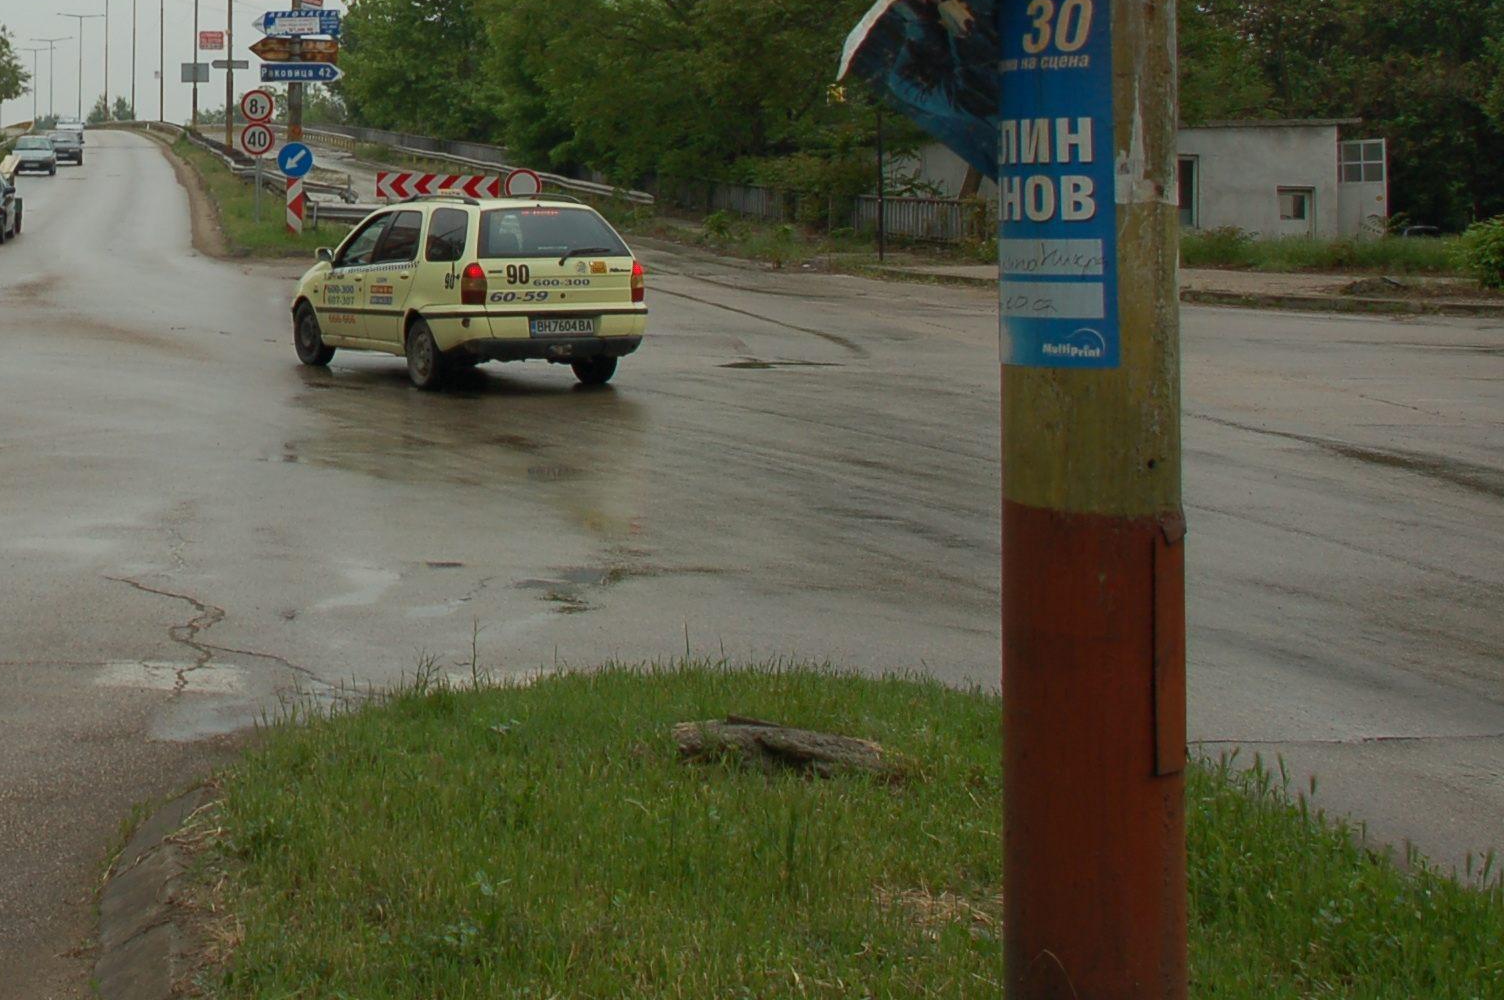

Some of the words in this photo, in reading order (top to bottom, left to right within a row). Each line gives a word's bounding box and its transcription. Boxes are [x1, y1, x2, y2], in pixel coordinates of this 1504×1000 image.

[1021, 56, 1037, 70] на
[1040, 54, 1090, 71] сцена
[247, 131, 267, 148] 40
[506, 264, 530, 285] 90
[533, 278, 590, 286] 600-300
[490, 291, 549, 302] 60-59
